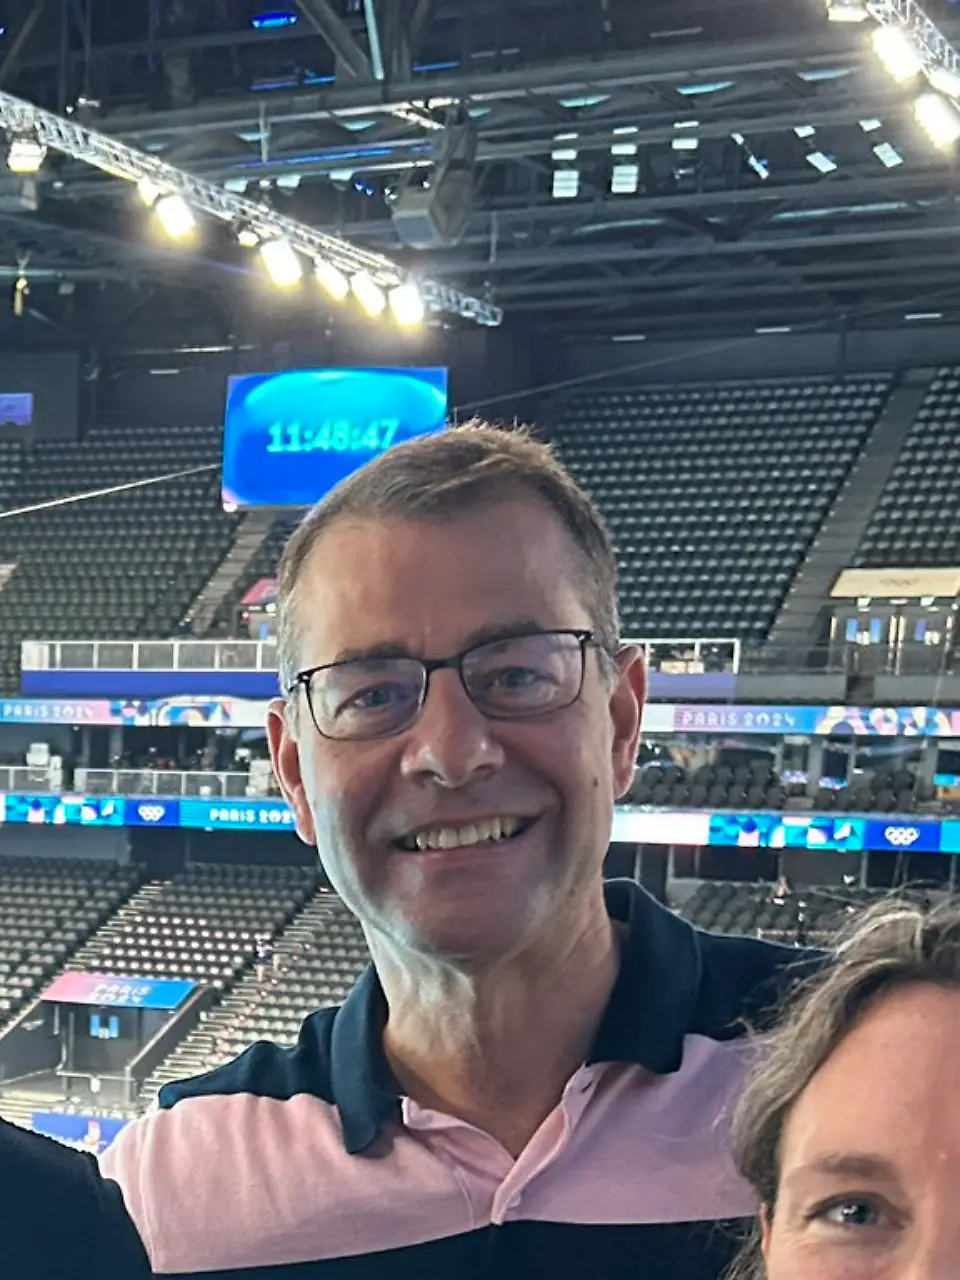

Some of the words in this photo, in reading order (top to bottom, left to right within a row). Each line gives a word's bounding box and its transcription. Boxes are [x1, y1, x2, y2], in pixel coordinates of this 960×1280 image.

[266, 418, 400, 453] 11:48:47
[2, 704, 48, 720] PARIS
[682, 711, 738, 727] PARIS
[743, 712, 797, 728] 2024
[209, 807, 256, 823] PARIS
[259, 809, 294, 824] 202
